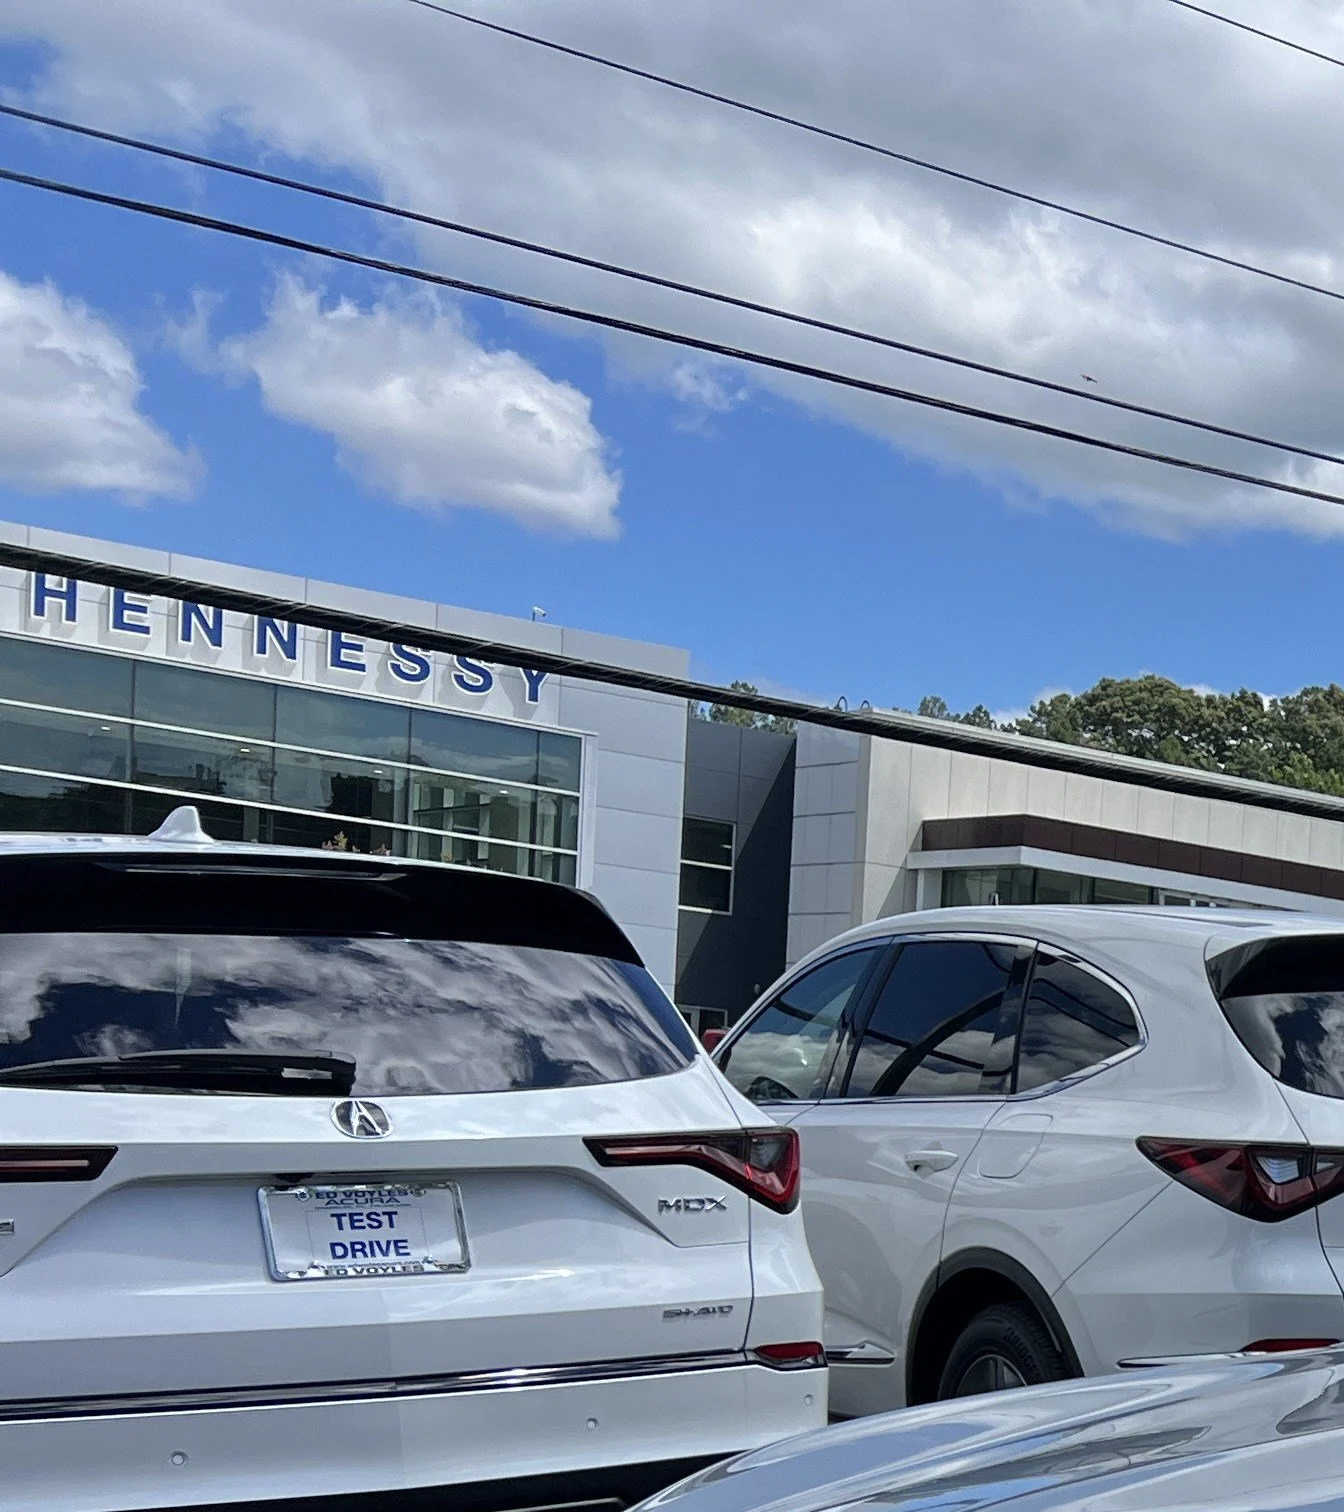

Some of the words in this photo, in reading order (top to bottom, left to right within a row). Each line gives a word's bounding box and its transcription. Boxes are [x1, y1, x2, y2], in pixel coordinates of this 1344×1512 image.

[31, 571, 550, 703] HENNESSY
[657, 1195, 728, 1214] MDX
[330, 1211, 398, 1231] TEST
[329, 1239, 411, 1260] DRIVE
